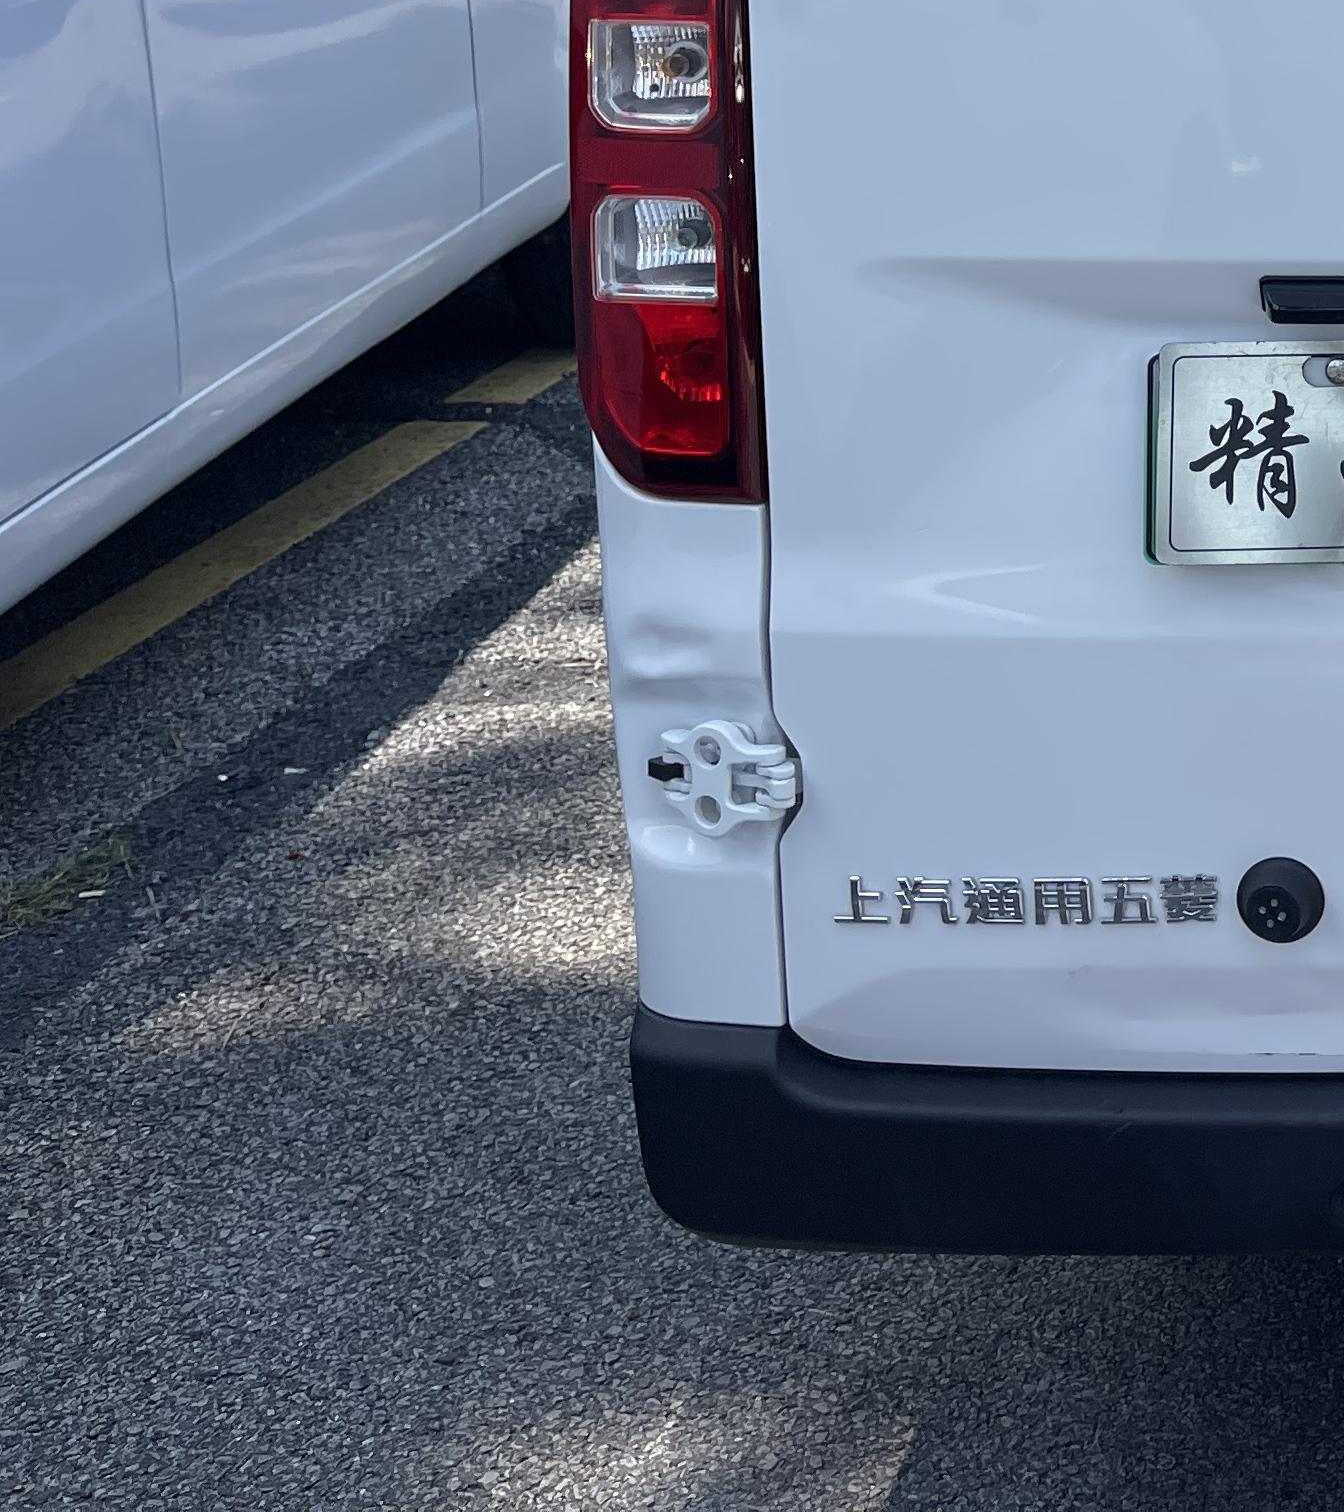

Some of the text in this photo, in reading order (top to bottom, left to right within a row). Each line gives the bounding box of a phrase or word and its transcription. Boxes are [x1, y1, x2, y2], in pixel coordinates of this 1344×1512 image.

[833, 874, 1218, 926] 上汽通用五菱
